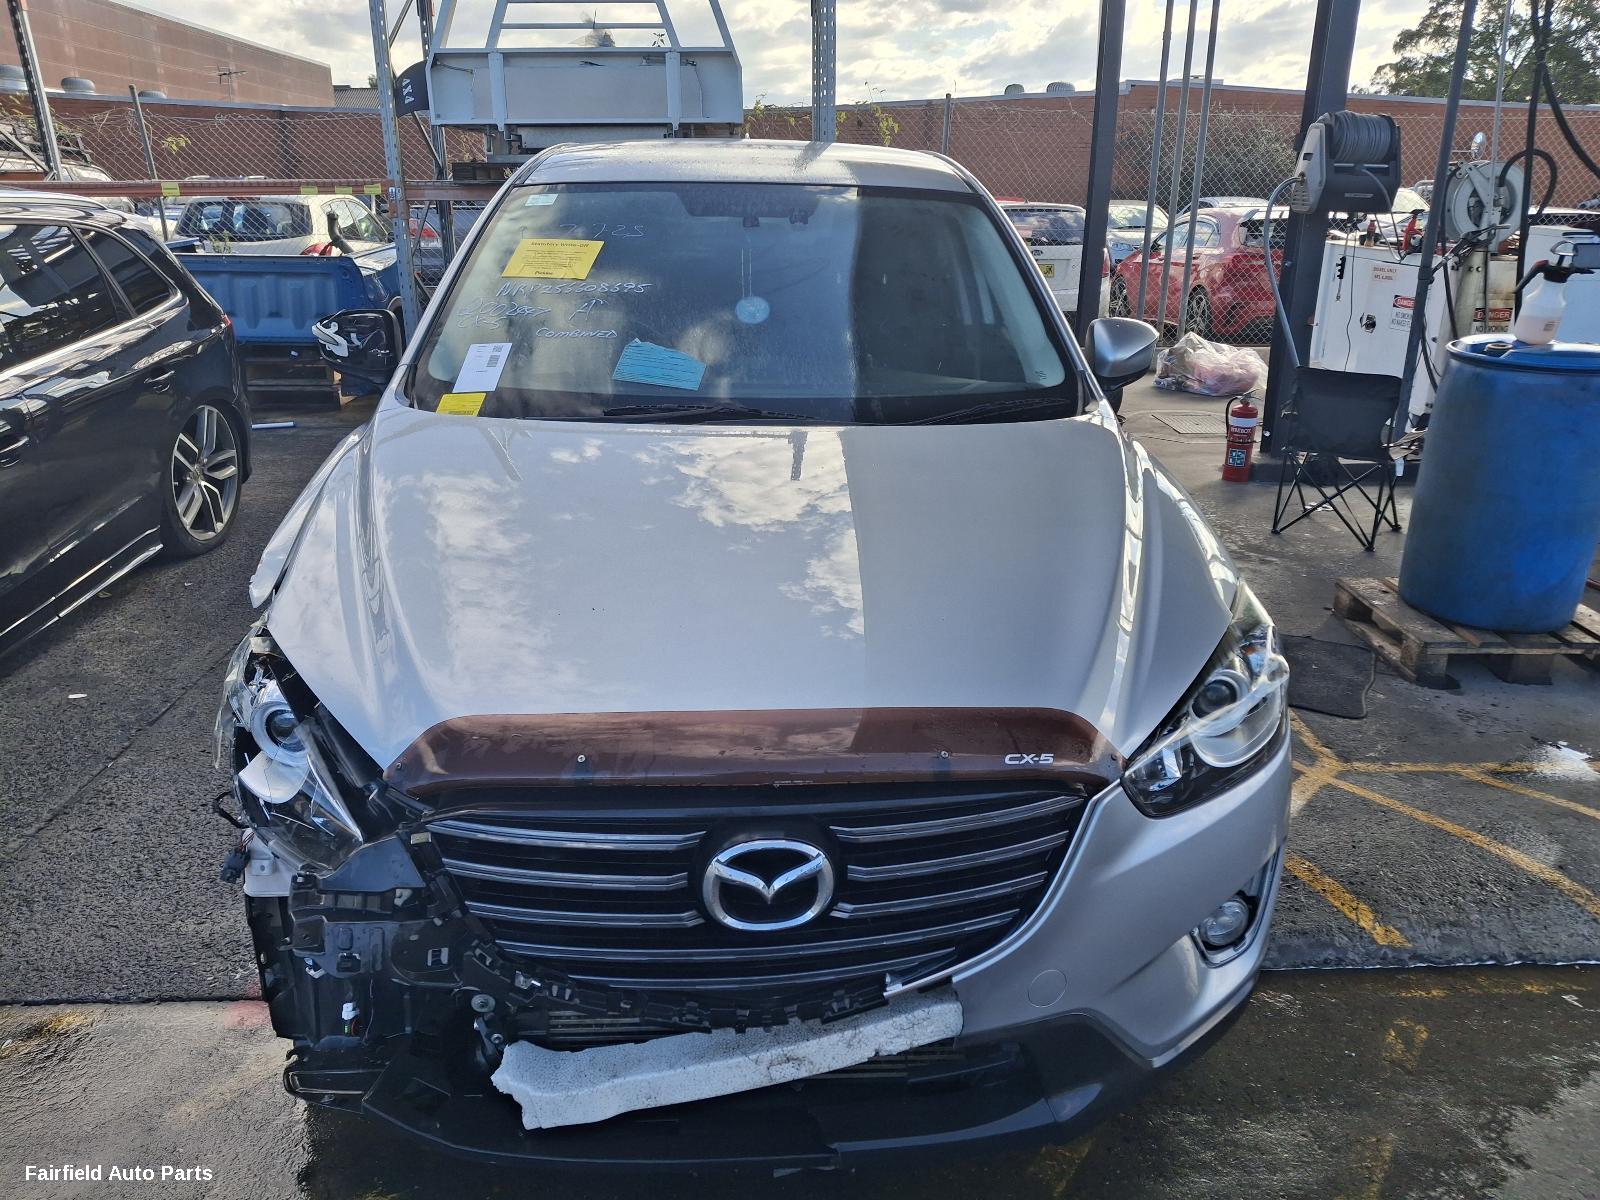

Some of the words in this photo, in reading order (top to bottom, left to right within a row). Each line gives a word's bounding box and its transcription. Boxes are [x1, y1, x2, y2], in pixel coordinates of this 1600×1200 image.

[1397, 299, 1416, 307] DANGE
[1477, 311, 1511, 320] DNGER
[1475, 325, 1484, 333] NO
[1004, 753, 1054, 765] CX-5
